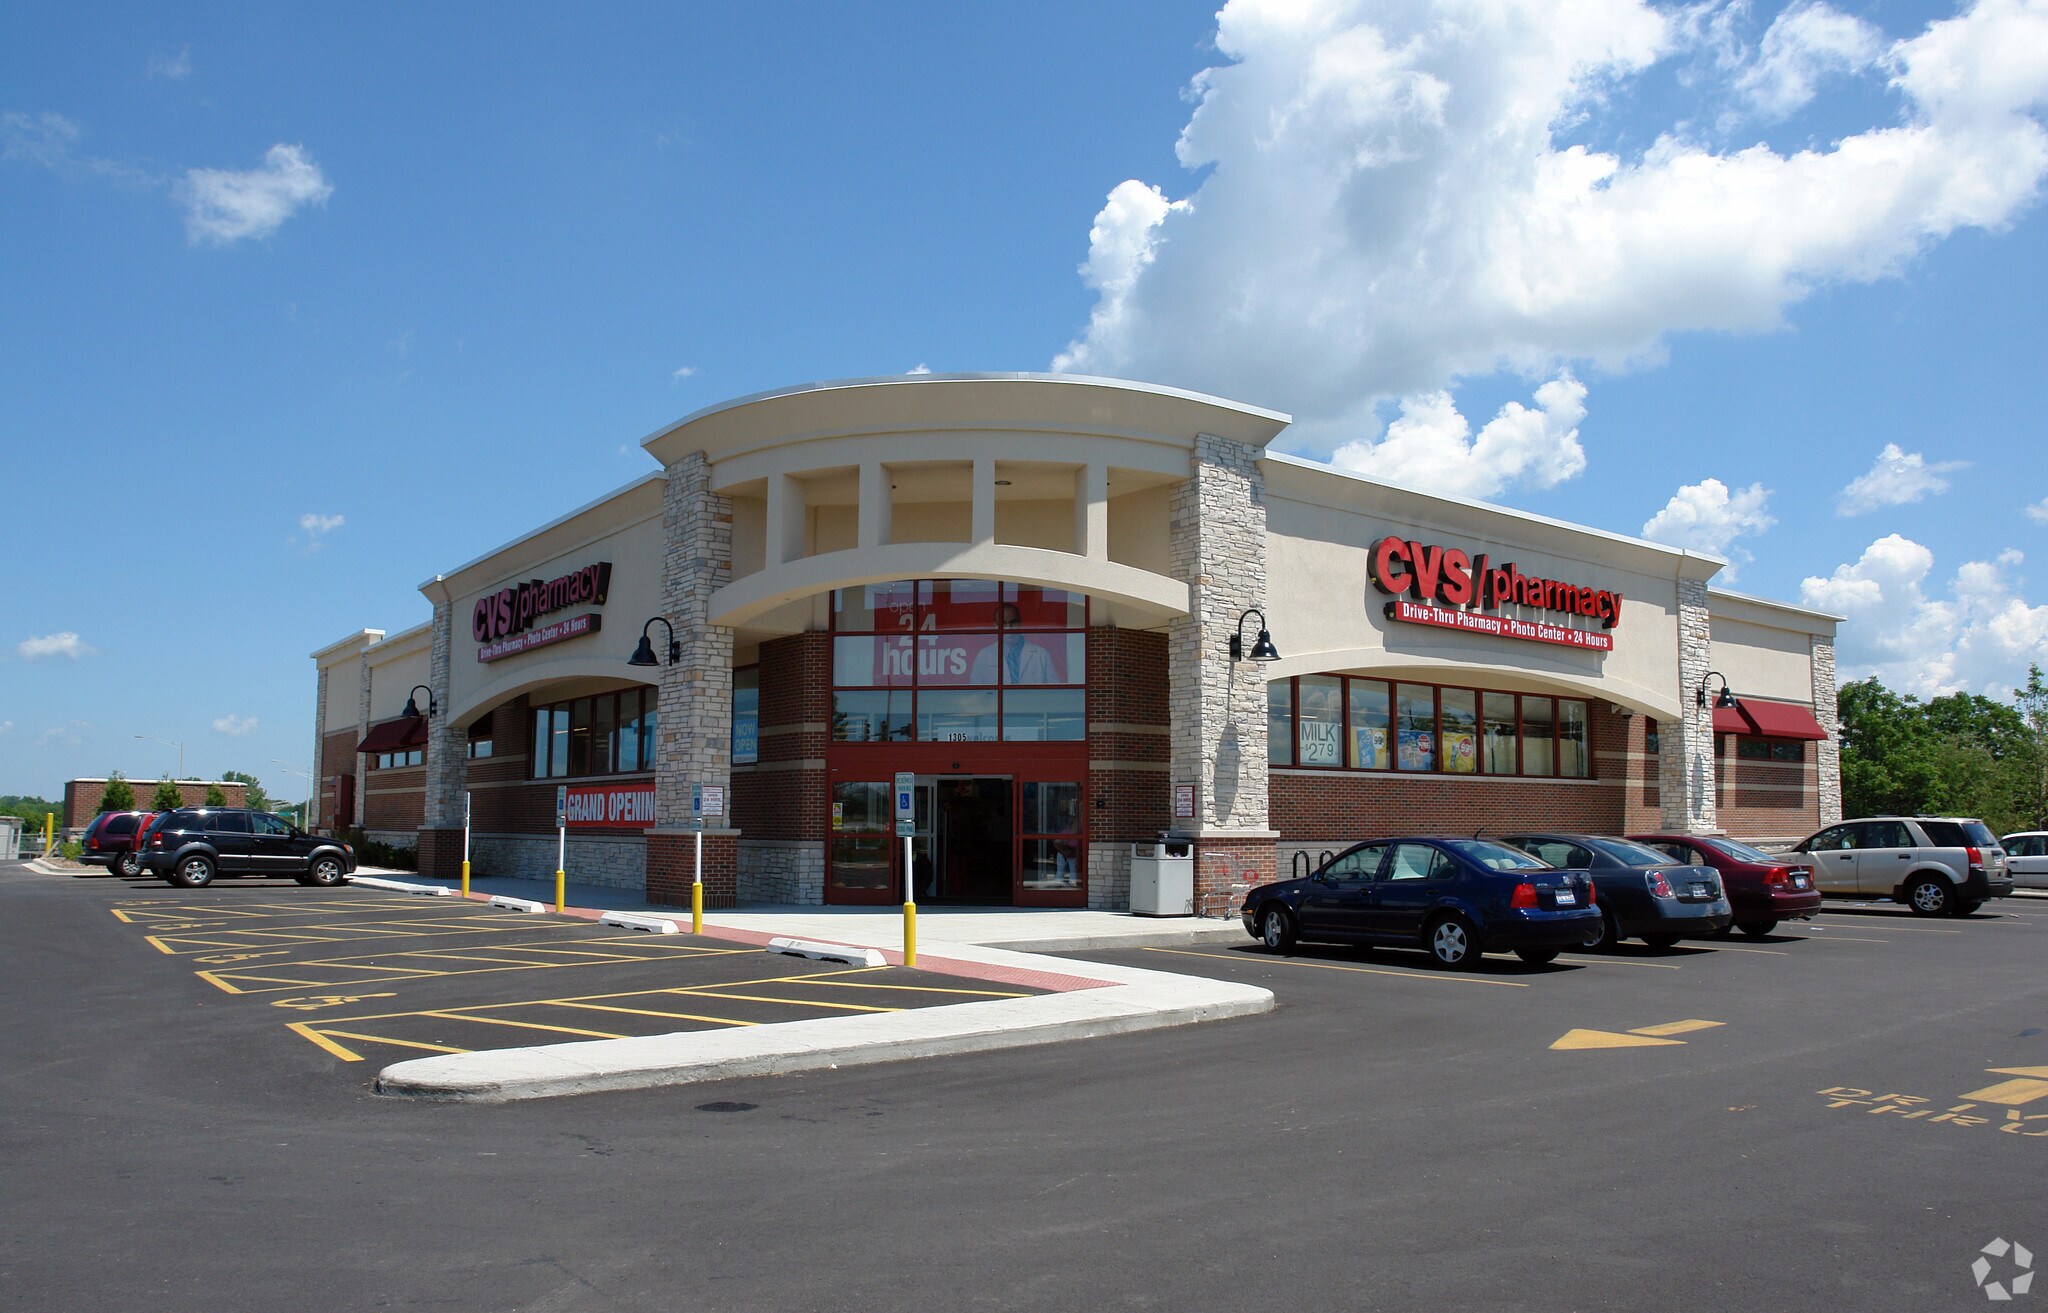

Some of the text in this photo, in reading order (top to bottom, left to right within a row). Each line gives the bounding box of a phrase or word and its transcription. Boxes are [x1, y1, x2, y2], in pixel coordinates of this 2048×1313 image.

[1374, 536, 1623, 629] CVS/pharmacy
[472, 562, 604, 643] CVS/pharmacy
[889, 602, 926, 615] open
[502, 638, 523, 653] Pharmacy
[527, 631, 541, 646] Photo
[542, 626, 559, 641] Center
[563, 621, 570, 635] 24
[571, 618, 587, 632] Hours
[899, 613, 939, 647] 24
[1403, 603, 1608, 648] Drive-Thru Pharmacy Photo Center 24 Hours
[882, 641, 967, 676] hours
[735, 721, 755, 737] NOW
[948, 733, 967, 742] 1305
[967, 732, 1011, 741] welcoe
[1301, 722, 1336, 742] MILK
[735, 739, 757, 752] OPEN
[567, 791, 655, 822] GRAND OPENIN
[1815, 1086, 2048, 1121] DRIV
